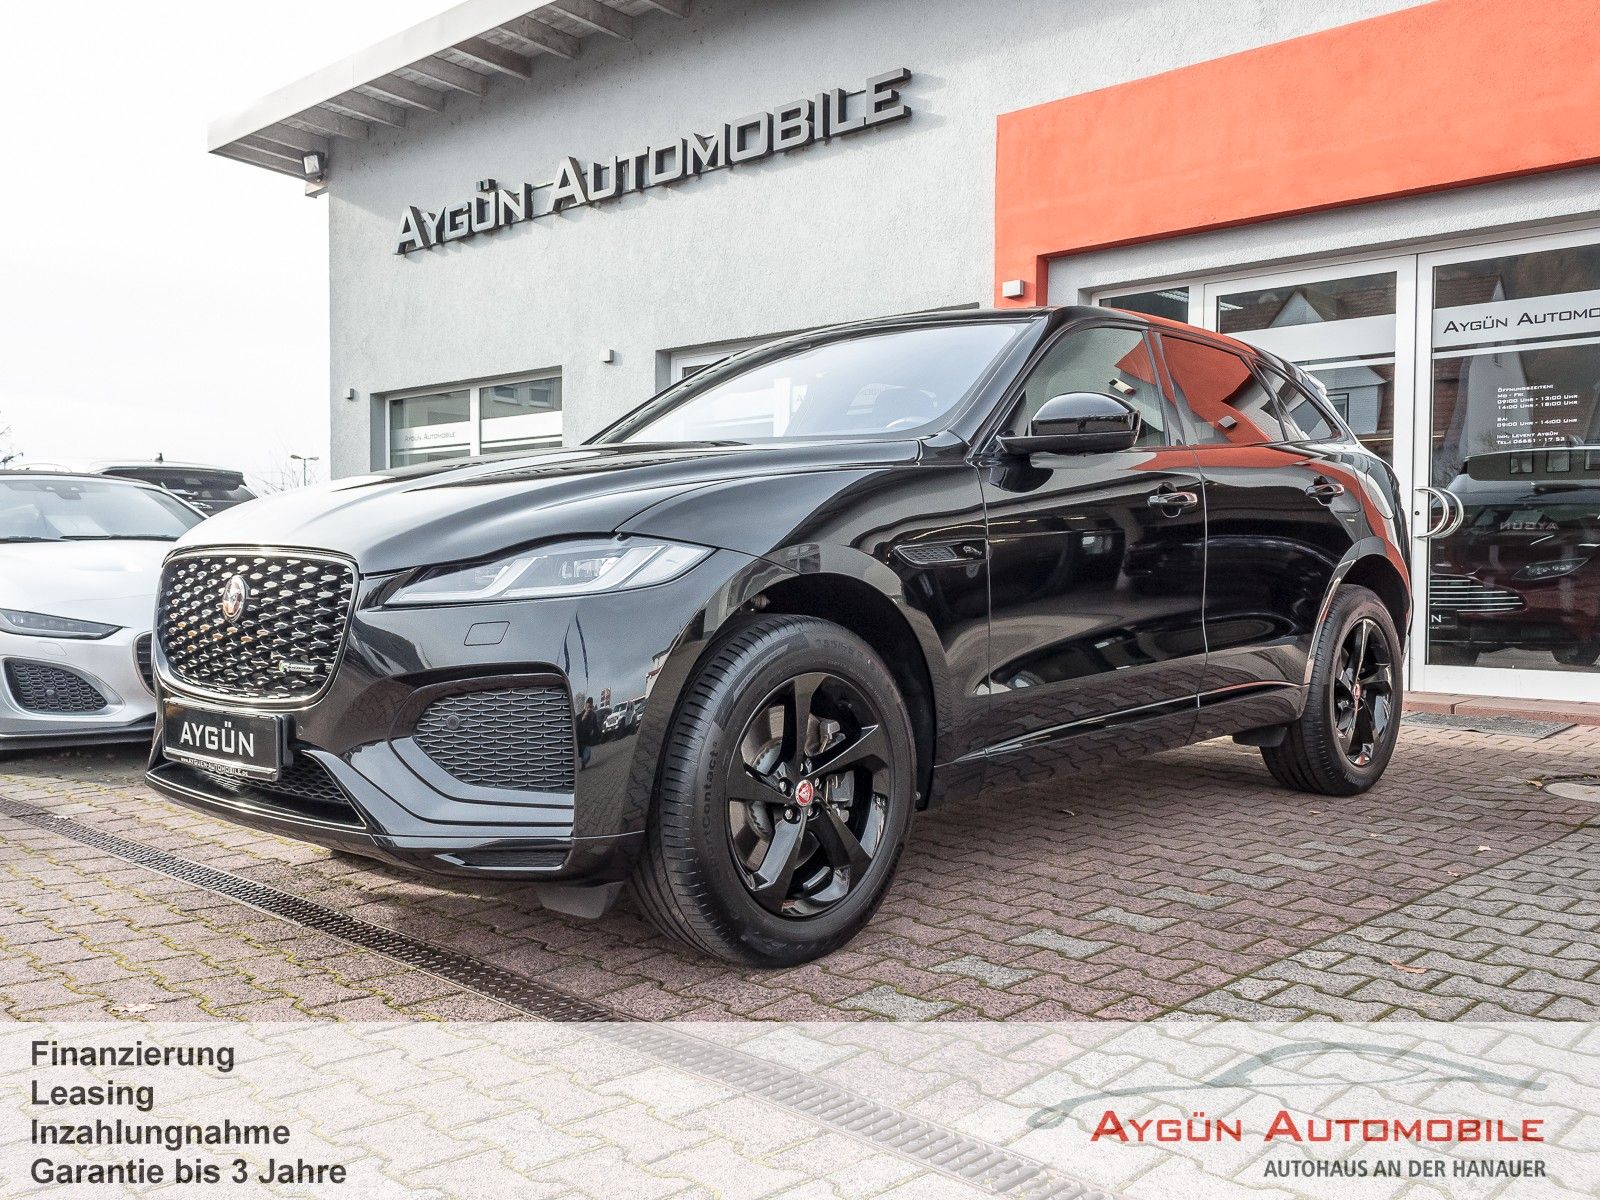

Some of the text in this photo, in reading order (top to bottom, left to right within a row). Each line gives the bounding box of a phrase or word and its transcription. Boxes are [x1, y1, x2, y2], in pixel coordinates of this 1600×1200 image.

[395, 67, 912, 254] AYGÜN AUTOMOBILE
[1443, 316, 1508, 334] AYGÜN
[179, 721, 255, 758] AYGÜN
